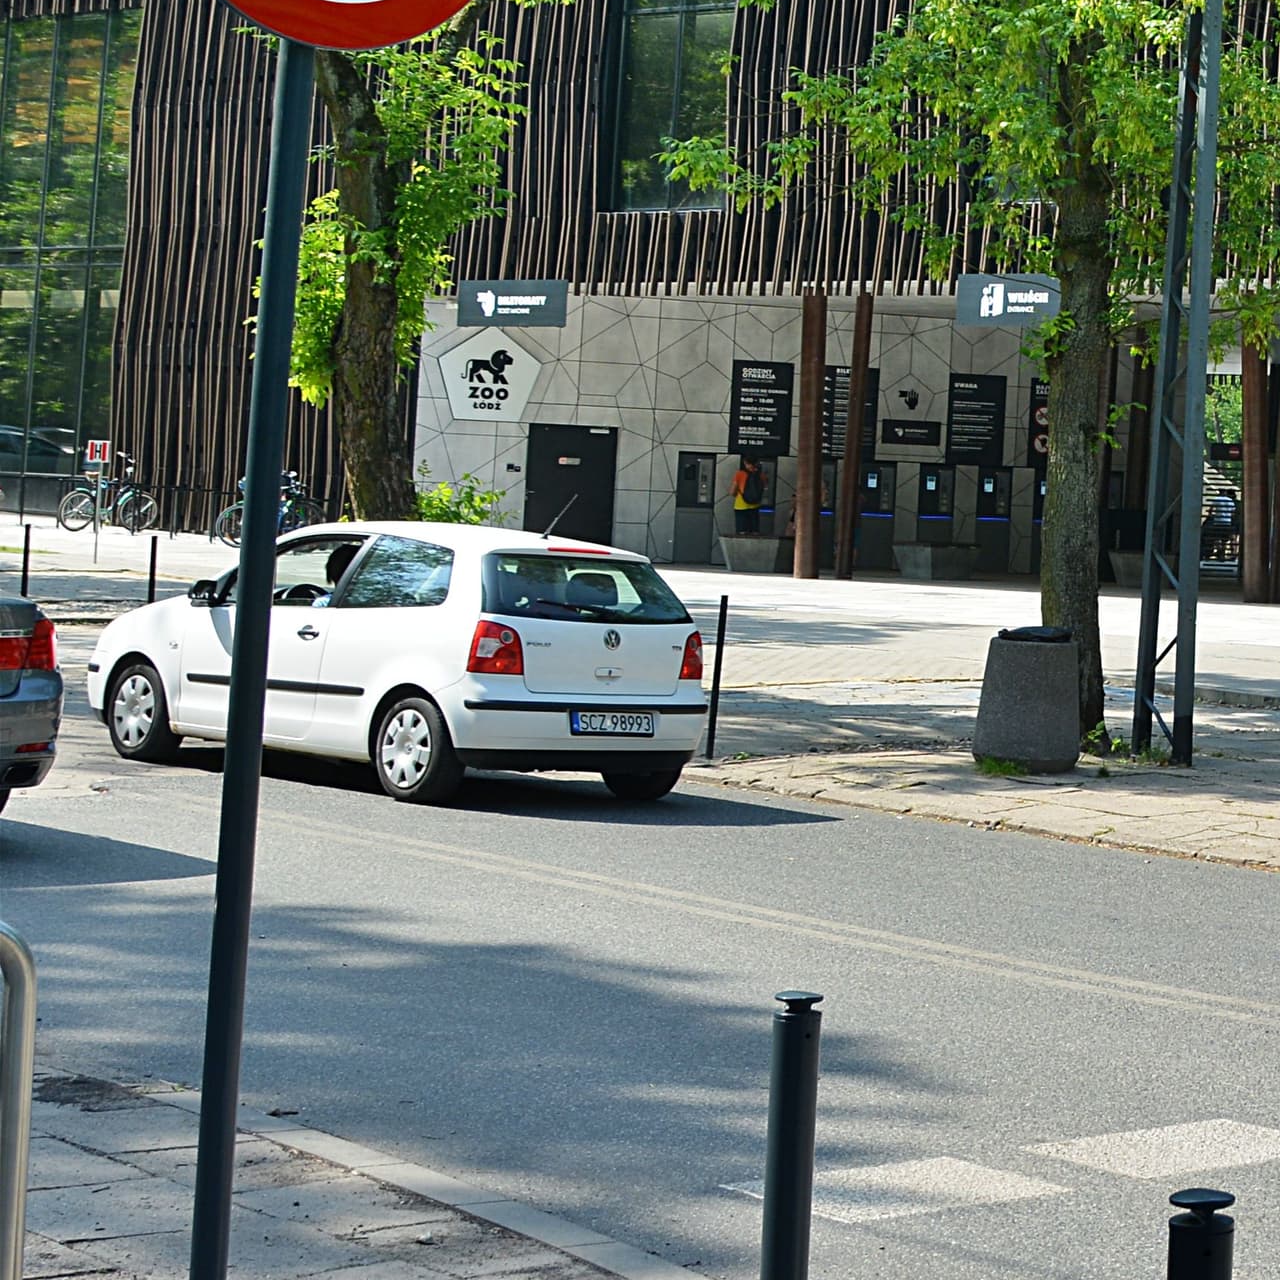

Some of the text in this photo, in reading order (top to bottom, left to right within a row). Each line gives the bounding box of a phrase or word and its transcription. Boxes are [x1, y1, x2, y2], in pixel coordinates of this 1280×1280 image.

[468, 386, 509, 401] ZOO
[473, 400, 502, 411] ŁÓDŹ
[580, 714, 651, 732] SCZ 98993
